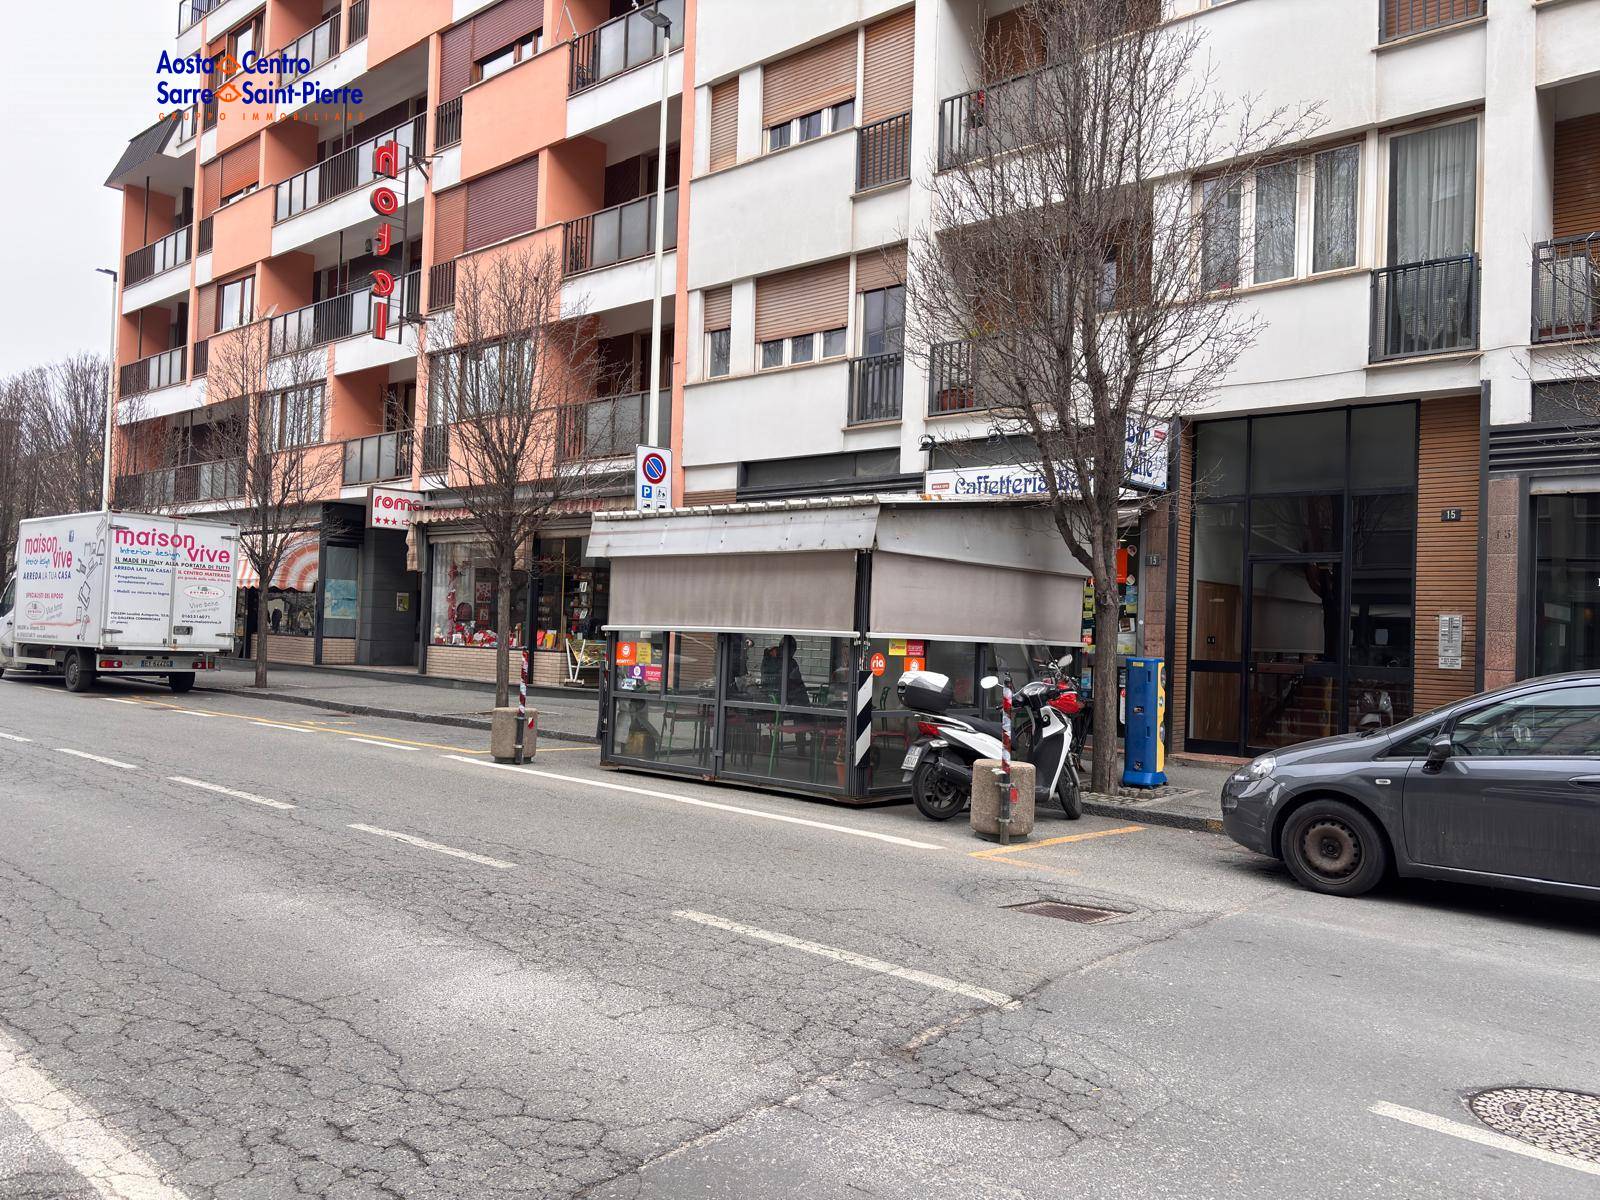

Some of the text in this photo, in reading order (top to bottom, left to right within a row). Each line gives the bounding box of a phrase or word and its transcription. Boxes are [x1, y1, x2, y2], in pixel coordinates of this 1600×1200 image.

[643, 486, 651, 498] P
[954, 474, 1050, 495] Caffetteria
[374, 495, 424, 512] roma
[1446, 510, 1456, 519] 15
[25, 533, 58, 555] maison
[115, 528, 195, 551] maison
[53, 546, 73, 568] vive
[187, 544, 230, 563] vive
[23, 571, 72, 580] ARREDA LA TUA CASA
[872, 655, 884, 668] ria
